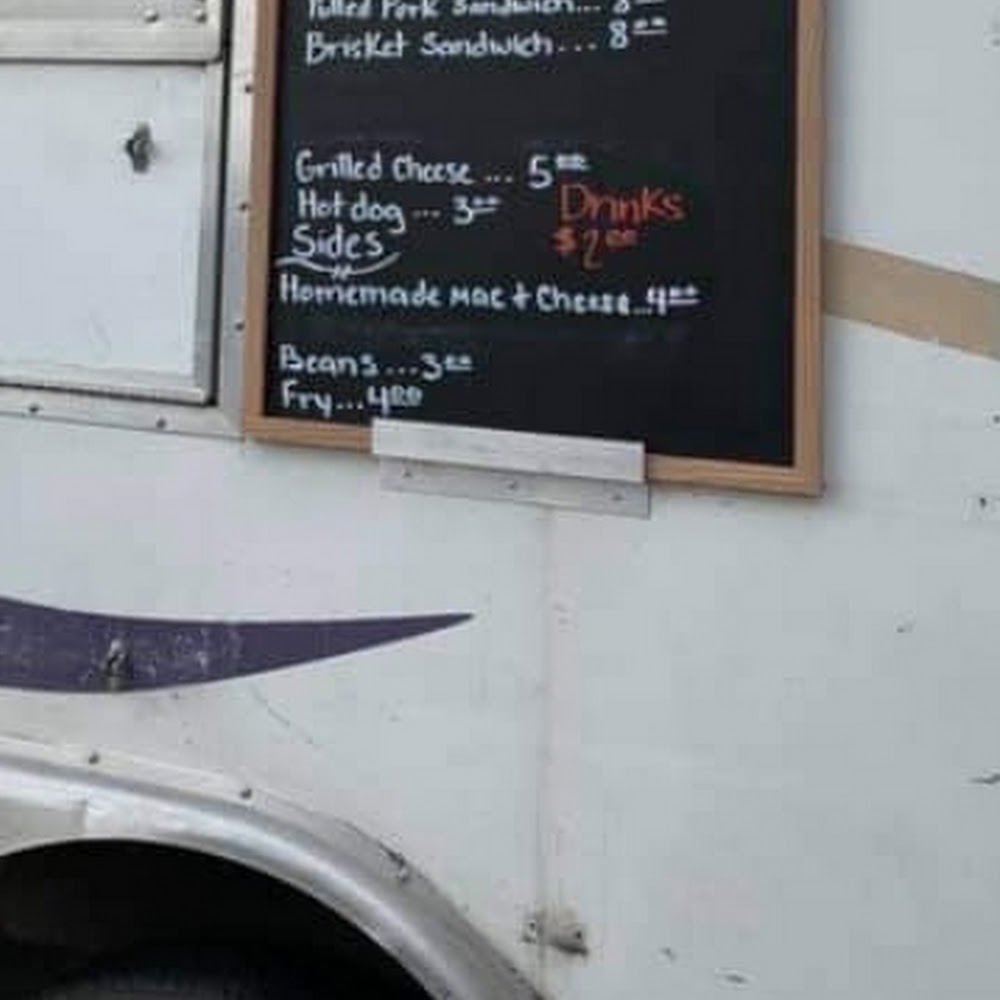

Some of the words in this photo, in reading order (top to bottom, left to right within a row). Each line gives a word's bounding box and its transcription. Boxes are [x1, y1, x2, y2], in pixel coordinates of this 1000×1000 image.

[306, 30, 409, 66] Brisket
[295, 149, 383, 184] Grilled
[560, 182, 686, 222] Drinks
[292, 222, 384, 259] Sides
[279, 273, 440, 307] Homemade
